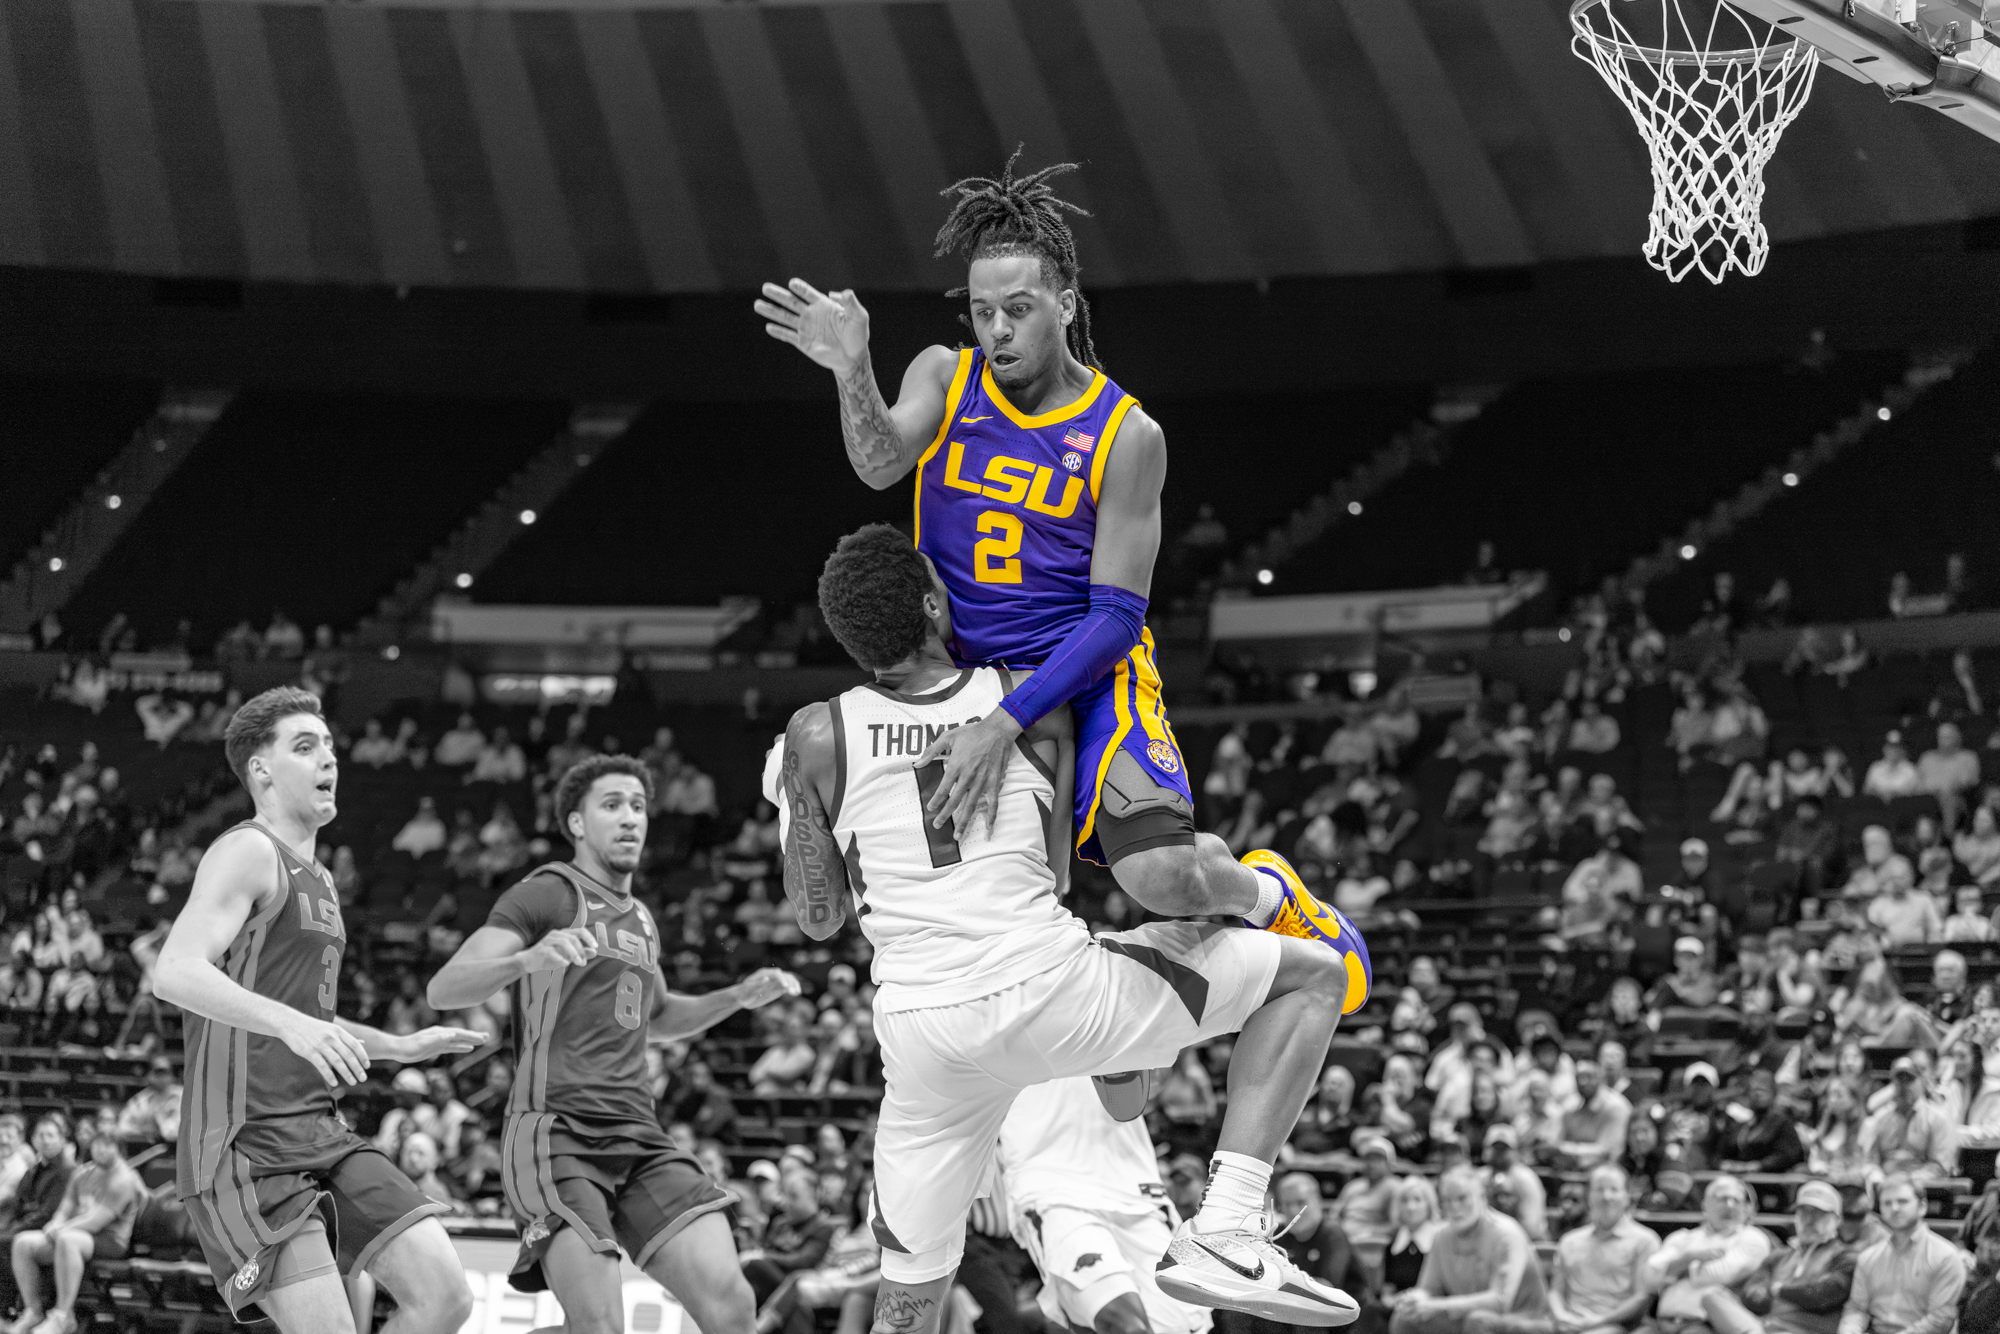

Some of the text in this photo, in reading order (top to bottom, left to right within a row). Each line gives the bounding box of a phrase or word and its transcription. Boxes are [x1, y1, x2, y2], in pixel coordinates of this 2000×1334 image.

[944, 441, 1085, 518] LSU
[1064, 453, 1080, 470] SEC
[974, 510, 1024, 584] 2
[868, 716, 982, 757] THOM
[788, 750, 832, 925] GODSPEED
[912, 759, 962, 869] 1
[318, 945, 340, 1010] 3
[595, 922, 657, 974] LSU
[615, 971, 643, 1031] 8
